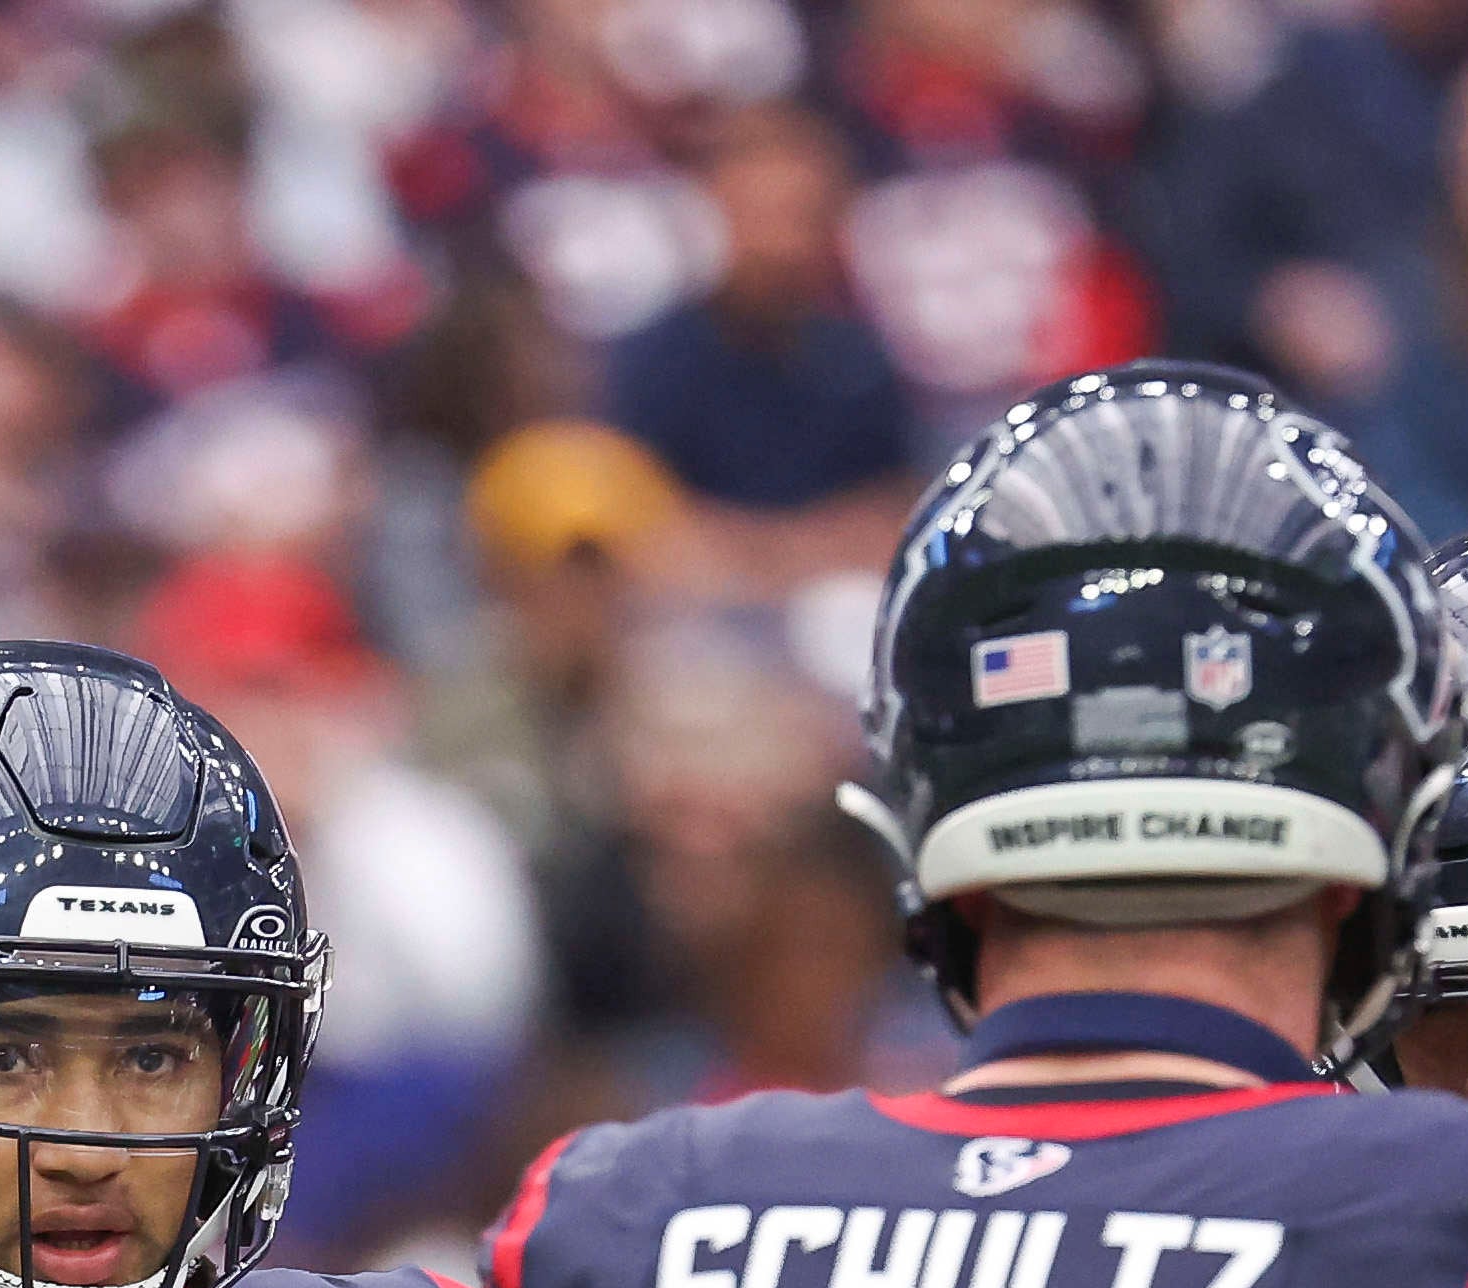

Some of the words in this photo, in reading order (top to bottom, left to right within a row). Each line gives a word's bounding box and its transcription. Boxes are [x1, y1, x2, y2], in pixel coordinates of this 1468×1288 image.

[987, 812, 1125, 853] INSPIRE
[1138, 812, 1292, 848] CHANGE
[57, 896, 175, 916] TEXANS
